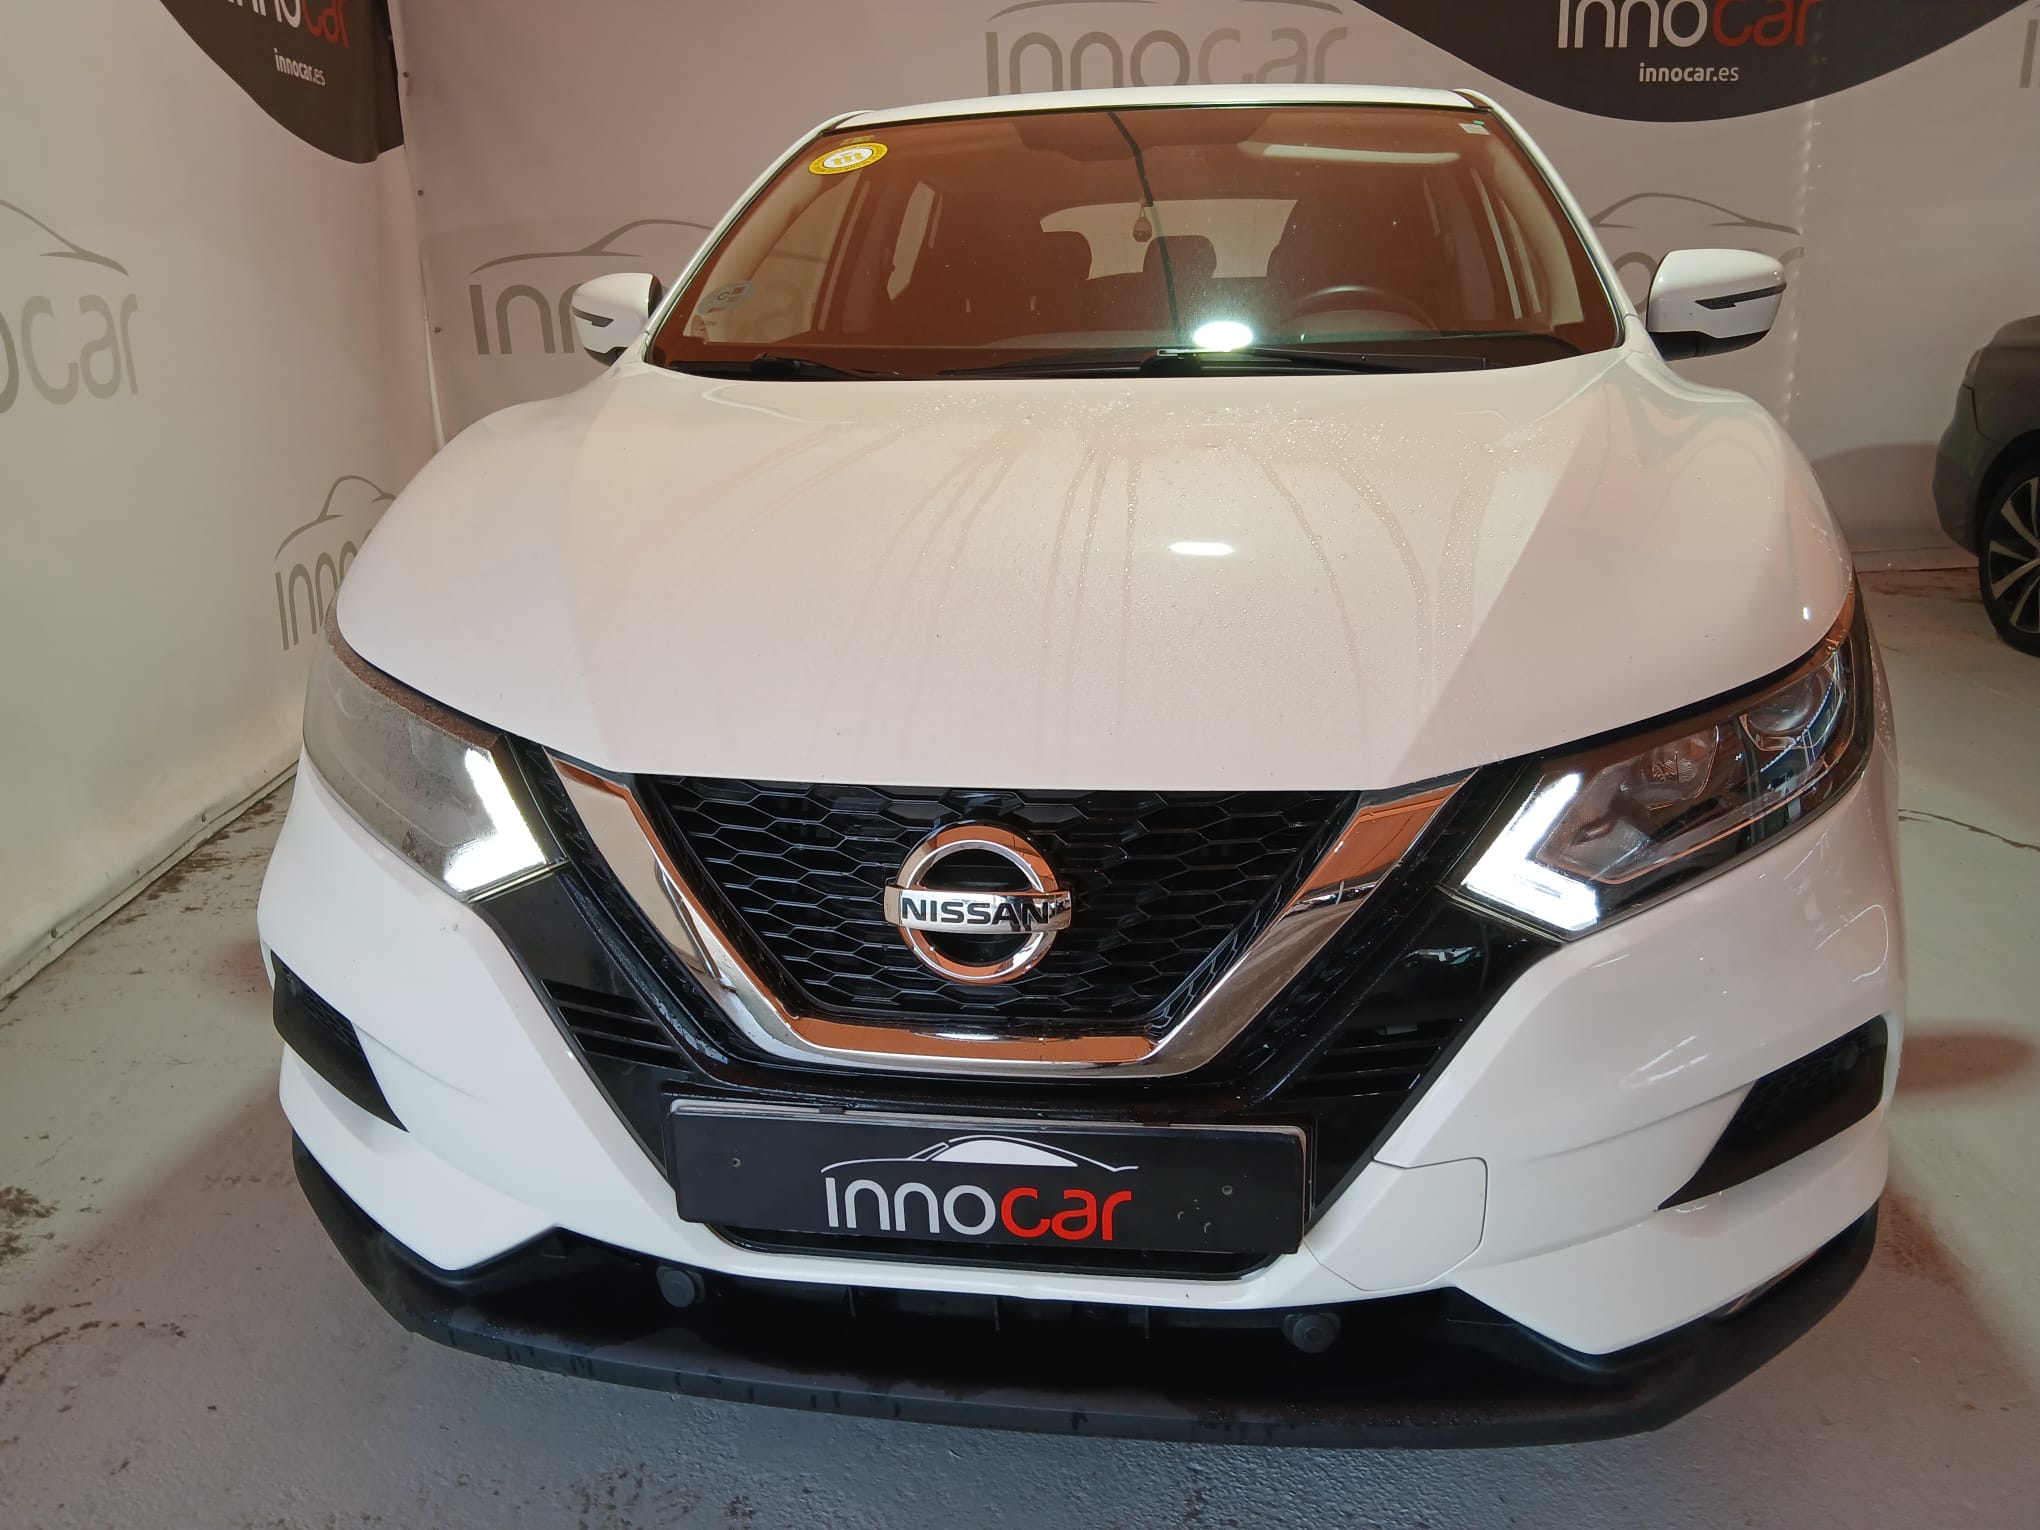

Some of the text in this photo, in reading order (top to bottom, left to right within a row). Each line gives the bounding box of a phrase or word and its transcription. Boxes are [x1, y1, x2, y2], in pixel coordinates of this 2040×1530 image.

[273, 47, 326, 86] innocar.es
[1639, 62, 1739, 82] innocar.es
[901, 897, 1049, 925] NISSAN
[825, 1177, 1132, 1241] innocar
